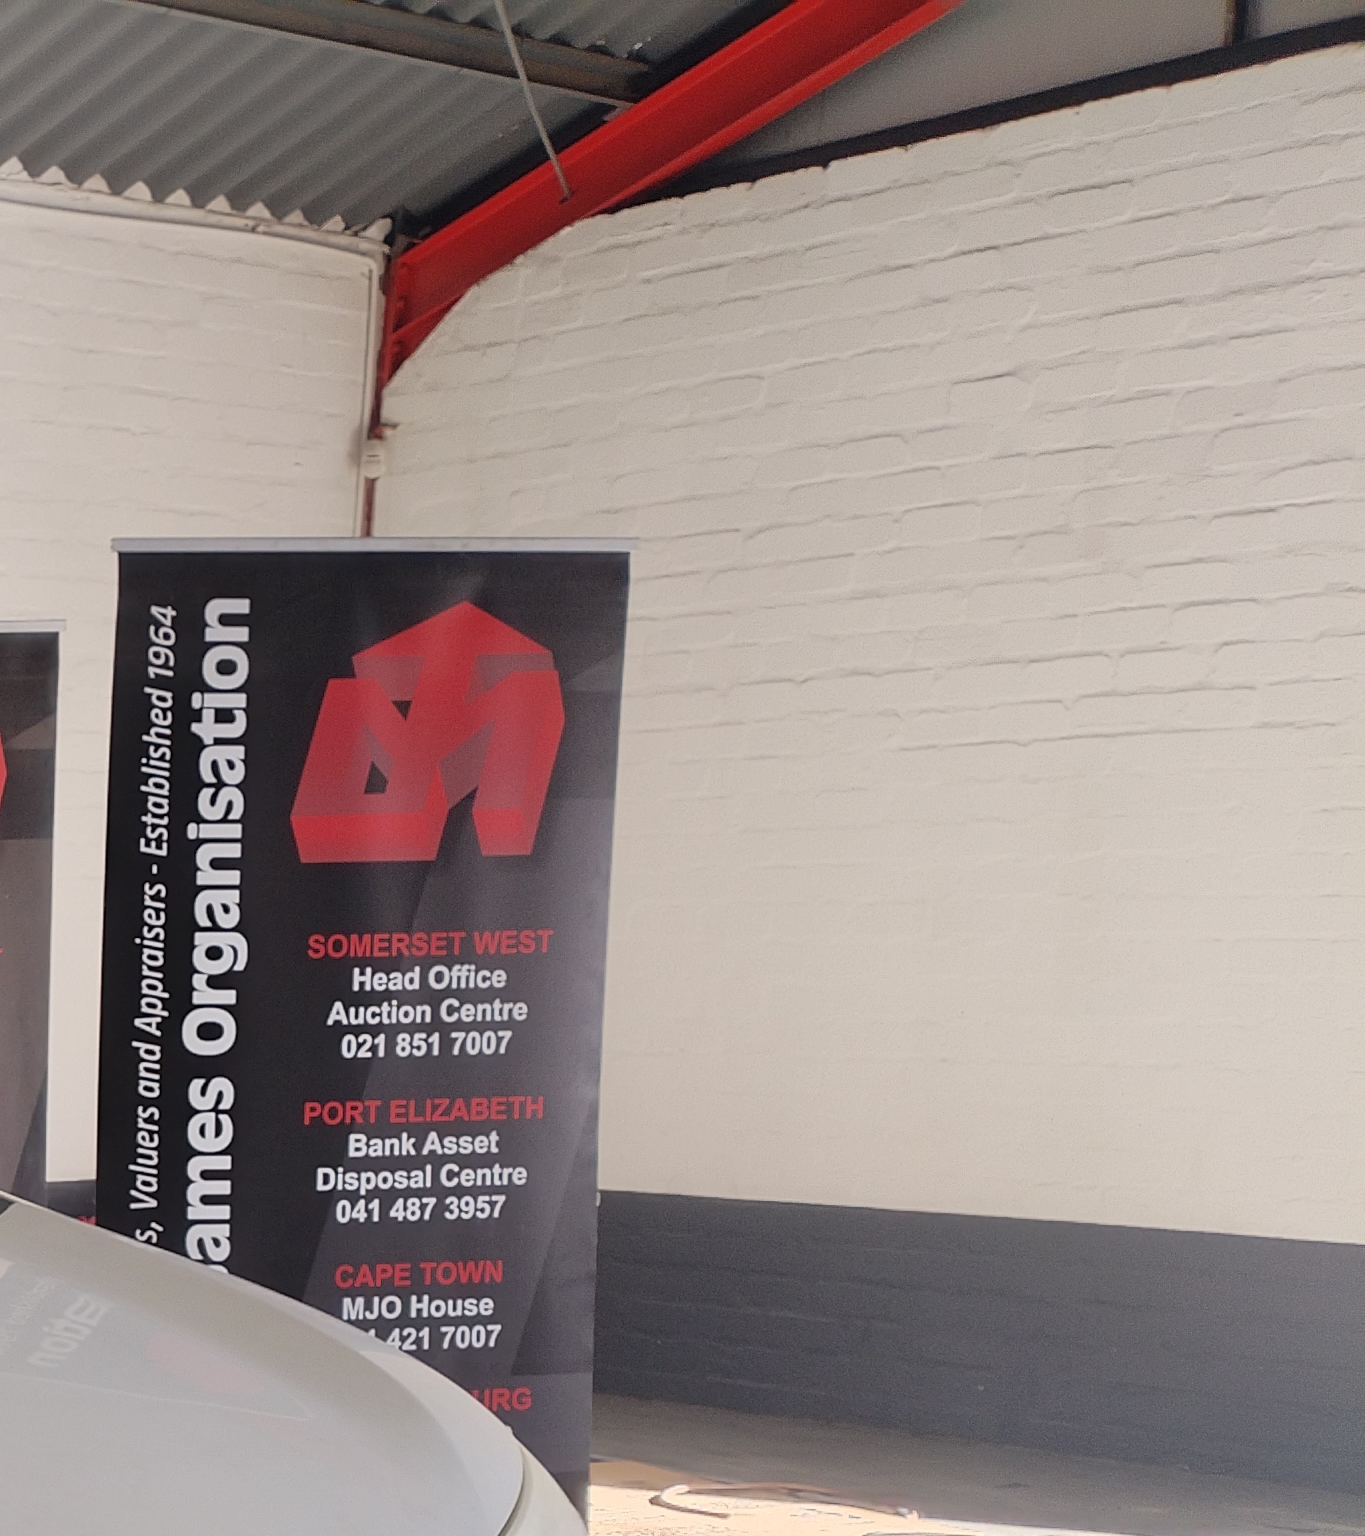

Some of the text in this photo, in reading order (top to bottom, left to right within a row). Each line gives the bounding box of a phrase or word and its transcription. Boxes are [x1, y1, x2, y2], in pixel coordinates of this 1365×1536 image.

[147, 605, 177, 679] 1964
[139, 686, 174, 857] Established
[181, 598, 251, 1273] ames Organisation
[307, 928, 554, 959] SOMERSET WEST
[133, 881, 170, 1037] Appraisers
[352, 964, 508, 992] Head Office
[326, 997, 529, 1026] Auction Centre
[341, 1030, 513, 1059] 021 851 7007
[131, 1035, 162, 1098] and
[303, 1095, 545, 1126] PORT ELIZABETH
[128, 1105, 160, 1210] Valuers
[348, 1130, 500, 1158] Bank Asset
[316, 1163, 529, 1196] Disposal Centre
[335, 1194, 507, 1224] 041 487 3957
[334, 1260, 504, 1289] CAPE TOWN
[342, 1294, 495, 1322] MJO House
[439, 1324, 503, 1350] 7007
